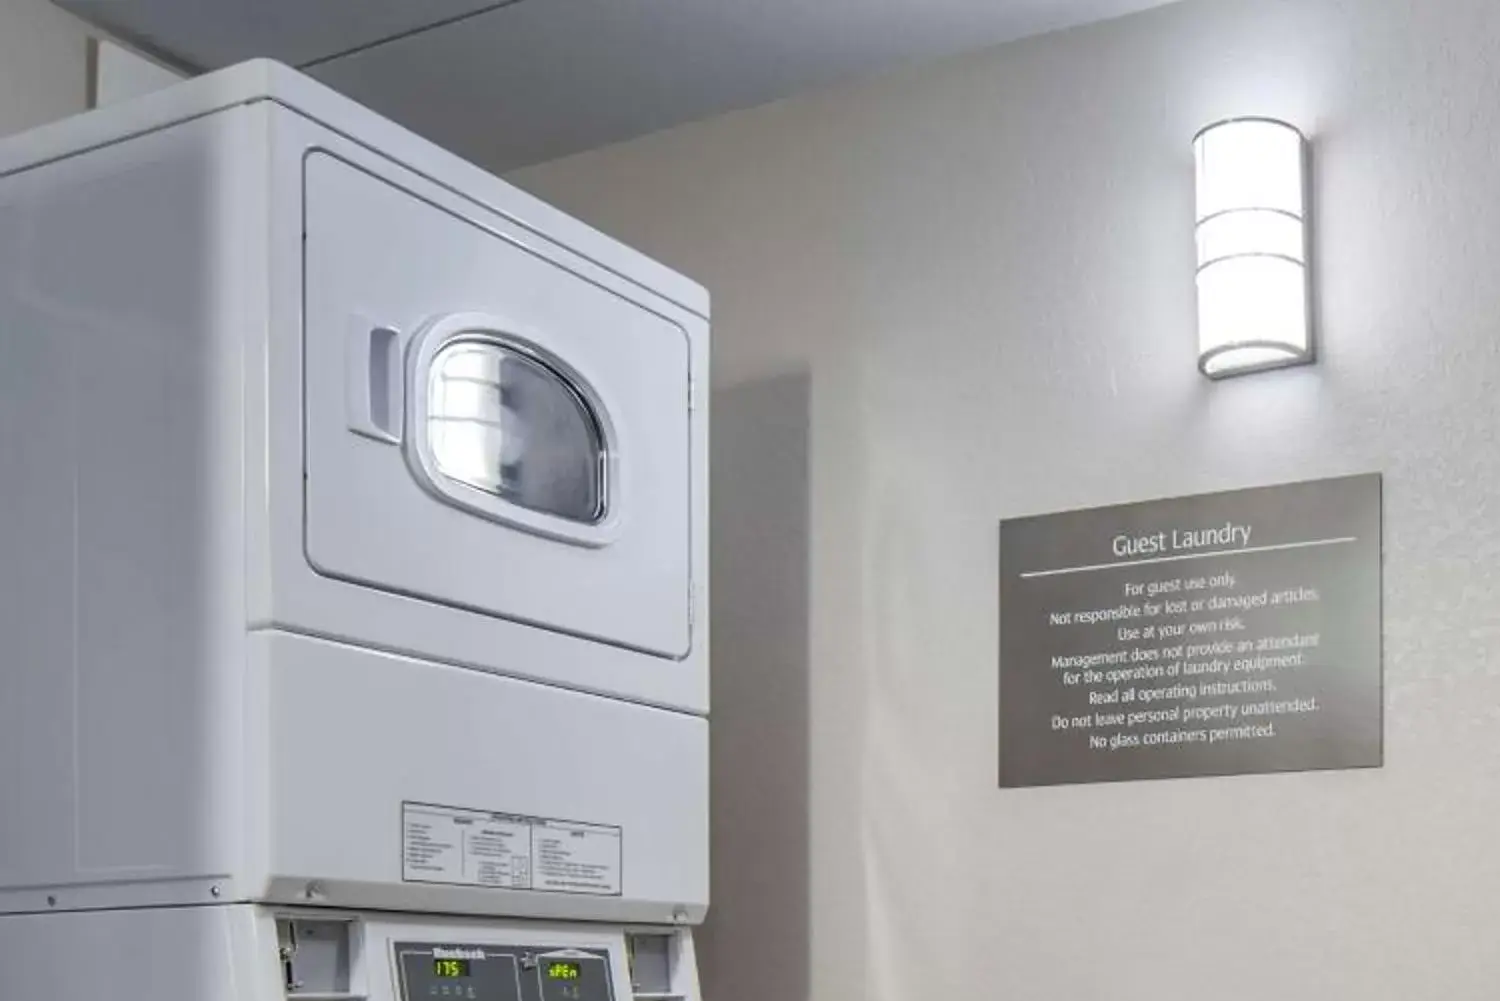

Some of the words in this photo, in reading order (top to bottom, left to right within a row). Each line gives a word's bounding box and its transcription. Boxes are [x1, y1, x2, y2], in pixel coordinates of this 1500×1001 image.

[1112, 531, 1167, 557] Guest
[1172, 521, 1252, 549] Laundry
[1125, 582, 1145, 597] For
[1147, 578, 1181, 597] guest
[1184, 577, 1206, 591] use
[1049, 612, 1072, 625] Not
[1074, 604, 1141, 624] responsible
[1143, 601, 1161, 617] for
[1165, 599, 1188, 614] lost
[1190, 601, 1204, 612] or
[1207, 589, 1268, 610] damaged
[1117, 627, 1141, 641] Use
[1142, 626, 1155, 639] at
[1157, 623, 1186, 640] your
[1189, 621, 1218, 634] own
[1051, 651, 1128, 669] Management
[1130, 647, 1160, 661] does
[1162, 645, 1184, 659] not
[1186, 638, 1234, 659] provide
[1237, 639, 1255, 653] an
[1256, 632, 1320, 651] attendant
[1063, 671, 1082, 685] for
[1083, 670, 1104, 684] the
[1105, 664, 1165, 685] operation
[1166, 661, 1181, 677] of
[1183, 659, 1231, 676] laundry
[1089, 688, 1119, 705] Read
[1121, 687, 1136, 703] all
[1138, 682, 1197, 704] operating
[1199, 679, 1278, 696] instructions.
[1051, 715, 1070, 730] Do
[1071, 715, 1093, 728] not
[1095, 711, 1126, 727] leave
[1127, 706, 1181, 727] personal
[1183, 703, 1239, 723] property
[1241, 696, 1321, 716] unattended.
[1089, 735, 1108, 749] No
[1109, 732, 1140, 751] glass
[1142, 729, 1208, 746] containers
[1209, 720, 1277, 744] permitted.
